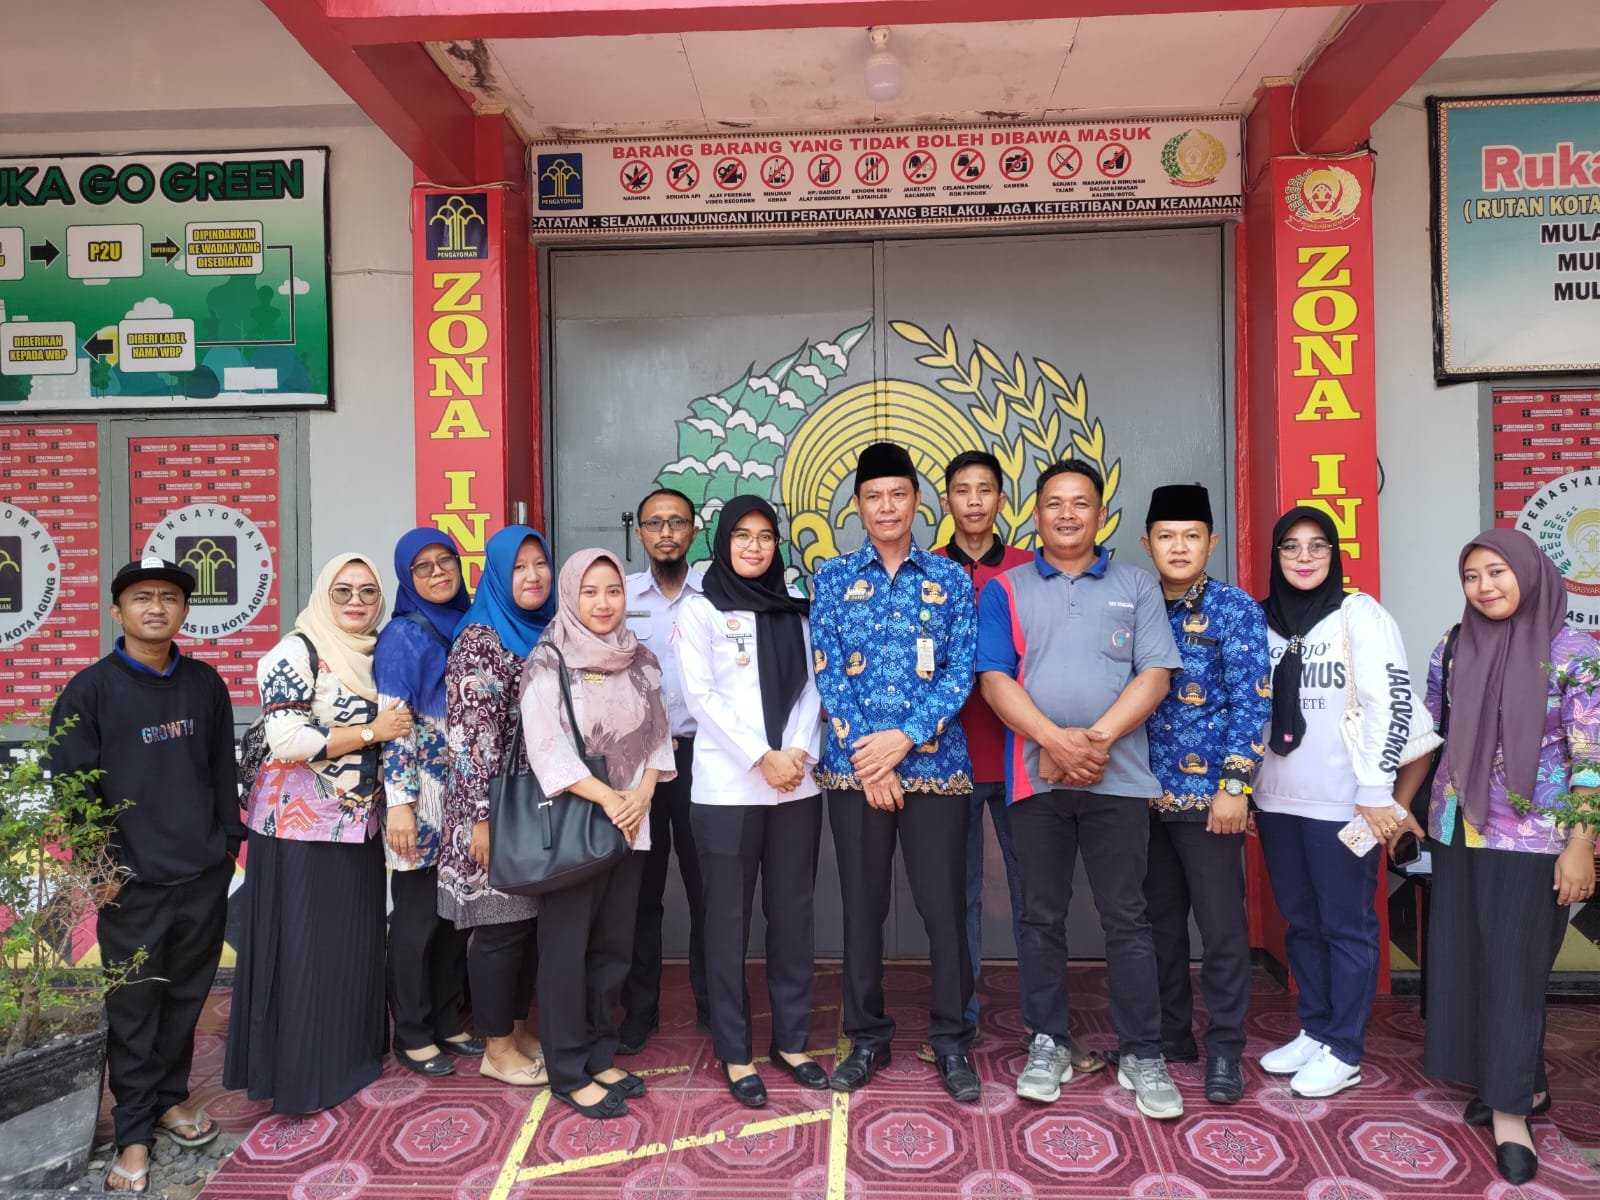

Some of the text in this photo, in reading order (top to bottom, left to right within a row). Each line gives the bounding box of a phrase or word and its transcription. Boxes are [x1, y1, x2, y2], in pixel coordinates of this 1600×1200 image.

[612, 126, 1152, 159] BARANG BARANG YANG TIDAK BOLEH DIBAWA MASUK
[79, 164, 155, 204] GO
[160, 159, 304, 202] GREEN
[600, 215, 656, 227] SELAMA
[660, 212, 748, 225] KUNJUNGAN
[751, 211, 788, 223] IKUTI
[791, 208, 874, 222] PERATURAN
[878, 206, 917, 219] YANG
[920, 204, 990, 218] BERLAKU.
[993, 202, 1031, 215] JAGA
[1035, 200, 1122, 214] KETERTIBAN
[1126, 199, 1158, 211] DAN
[1161, 196, 1242, 210] KEAMANAN
[1476, 196, 1544, 219] RUTAN
[1550, 194, 1600, 217] KOTA
[188, 242, 261, 255] KE WADAH YANG
[193, 228, 256, 241] DIPINDAHKAN
[88, 241, 122, 262] P2U
[197, 256, 253, 268] DISEDIAKAN
[13, 335, 63, 348] DIBERIKAN
[127, 332, 187, 345] DIBERI LABEL
[1291, 245, 1361, 422] ZONA
[9, 348, 68, 362] KEPADA WBP
[131, 346, 183, 359] NAMA WBP
[427, 271, 491, 440] ZONA
[1521, 475, 1600, 532] PEMASYA
[4, 509, 51, 554] OMAN
[149, 508, 264, 553] PENGAYOMAN
[5, 619, 36, 642] KOTA
[33, 577, 56, 621] AGUNG
[182, 622, 198, 633] AS
[212, 624, 220, 634] B
[222, 611, 250, 632] KOTA
[250, 573, 269, 613] AGUNG
[1564, 610, 1585, 624] AS
[1300, 661, 1347, 689] MUS
